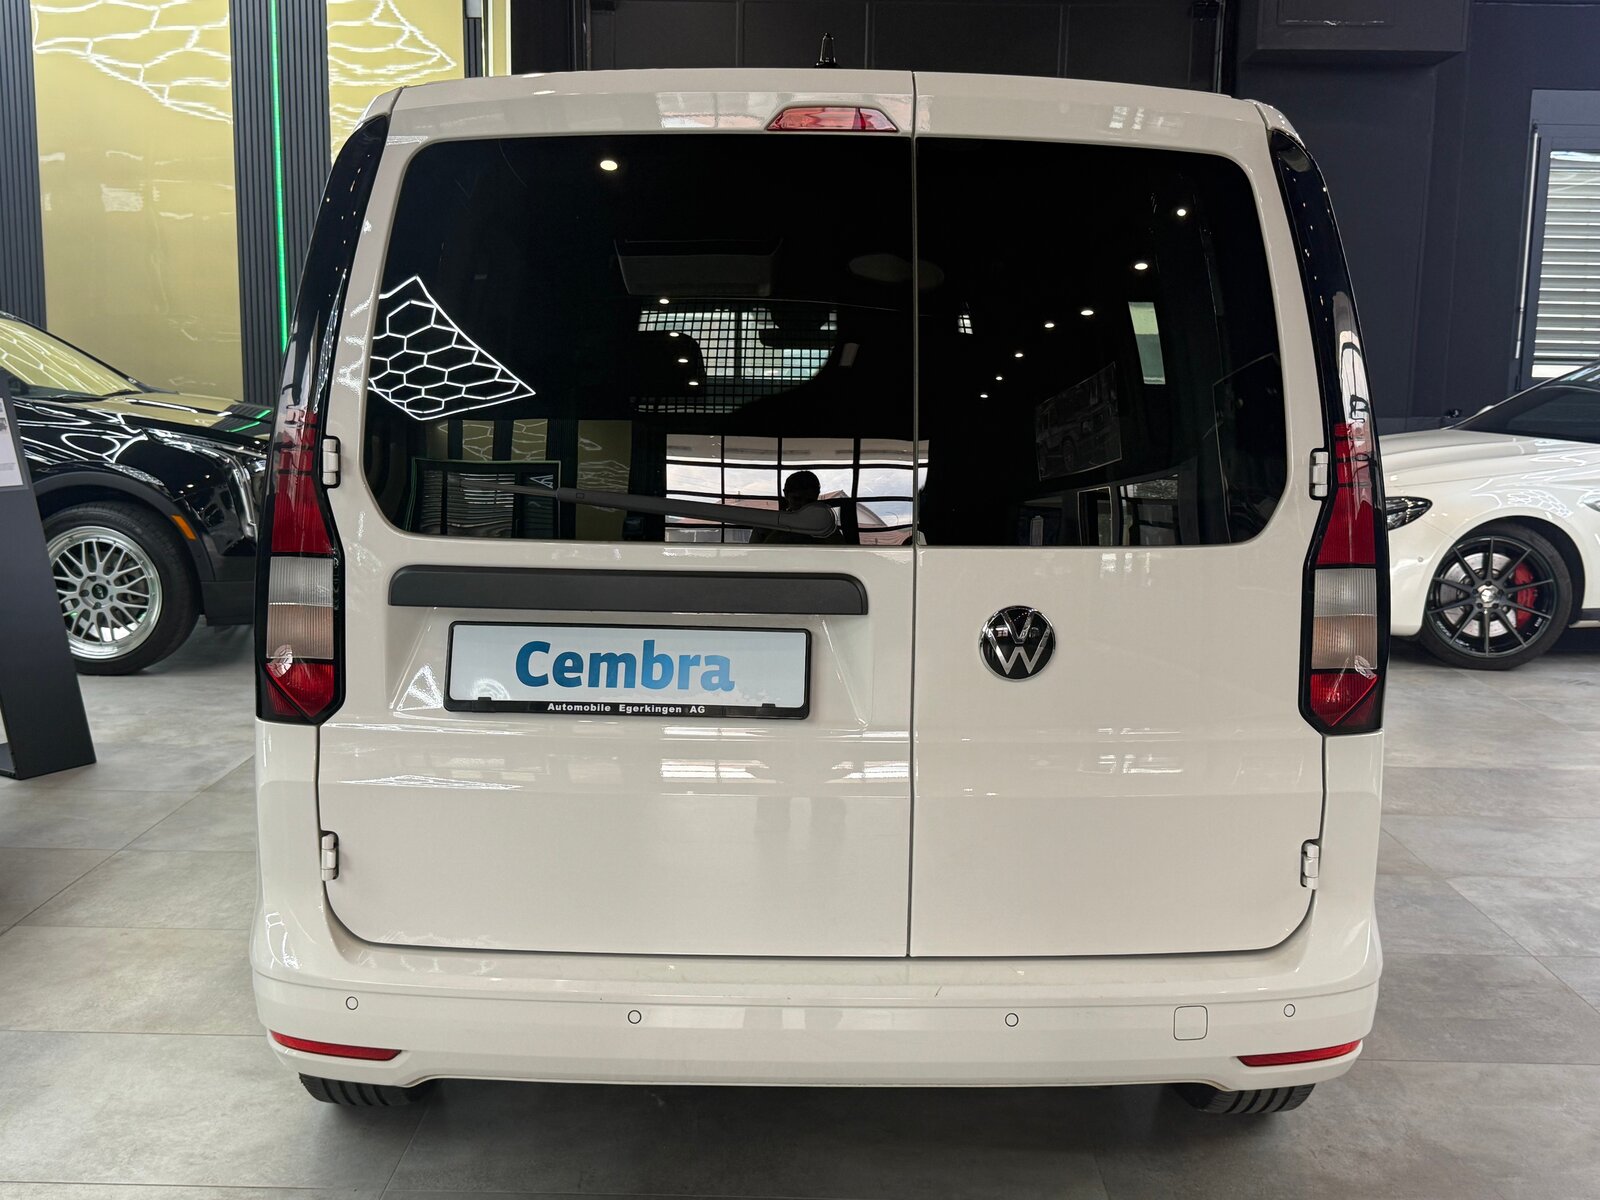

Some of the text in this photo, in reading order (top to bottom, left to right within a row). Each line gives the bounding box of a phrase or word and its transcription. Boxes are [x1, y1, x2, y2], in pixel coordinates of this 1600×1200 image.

[515, 639, 735, 692] Cembra
[547, 702, 706, 715] Automobile Egerkingen AG
